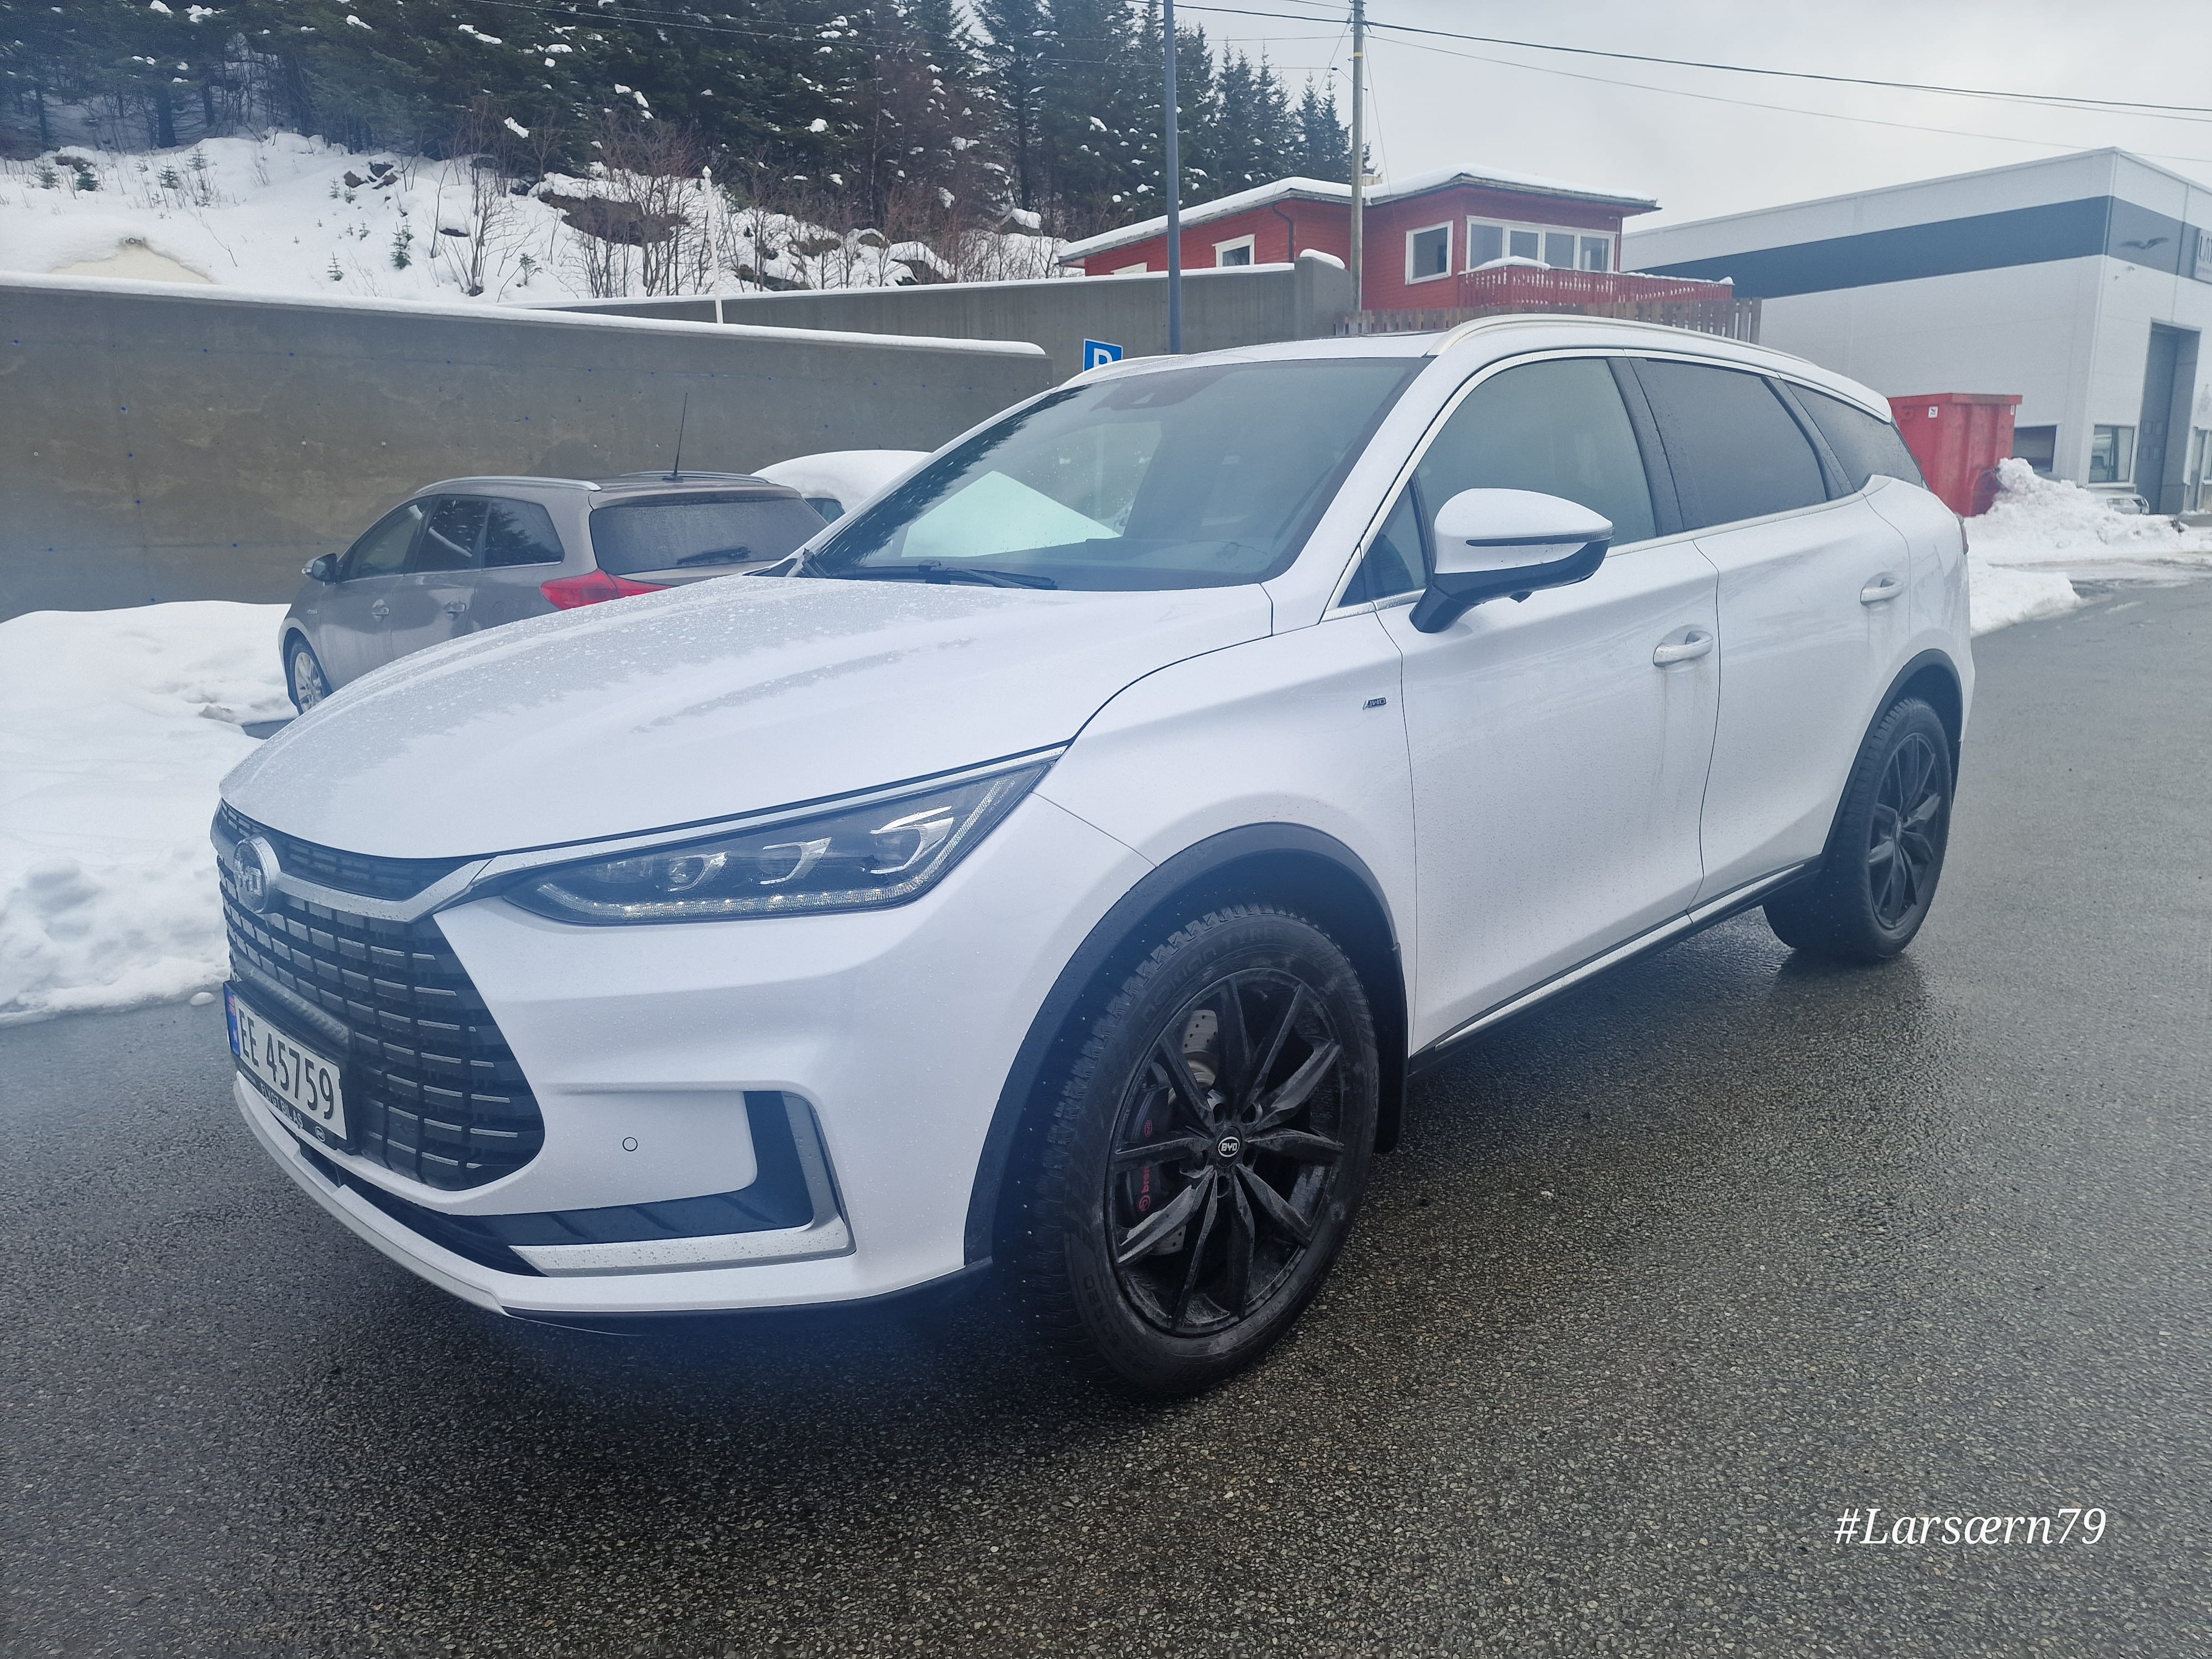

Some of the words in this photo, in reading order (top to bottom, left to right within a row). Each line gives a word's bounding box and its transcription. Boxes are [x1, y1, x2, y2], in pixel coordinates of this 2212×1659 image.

[1363, 697, 1386, 710] AWD
[239, 1008, 259, 1067] EE
[267, 1032, 334, 1120] 45759
[260, 1083, 279, 1110] FLYGT
[281, 1100, 293, 1120] BIL
[293, 1109, 304, 1129] AS
[1221, 1142, 1238, 1151] BYD
